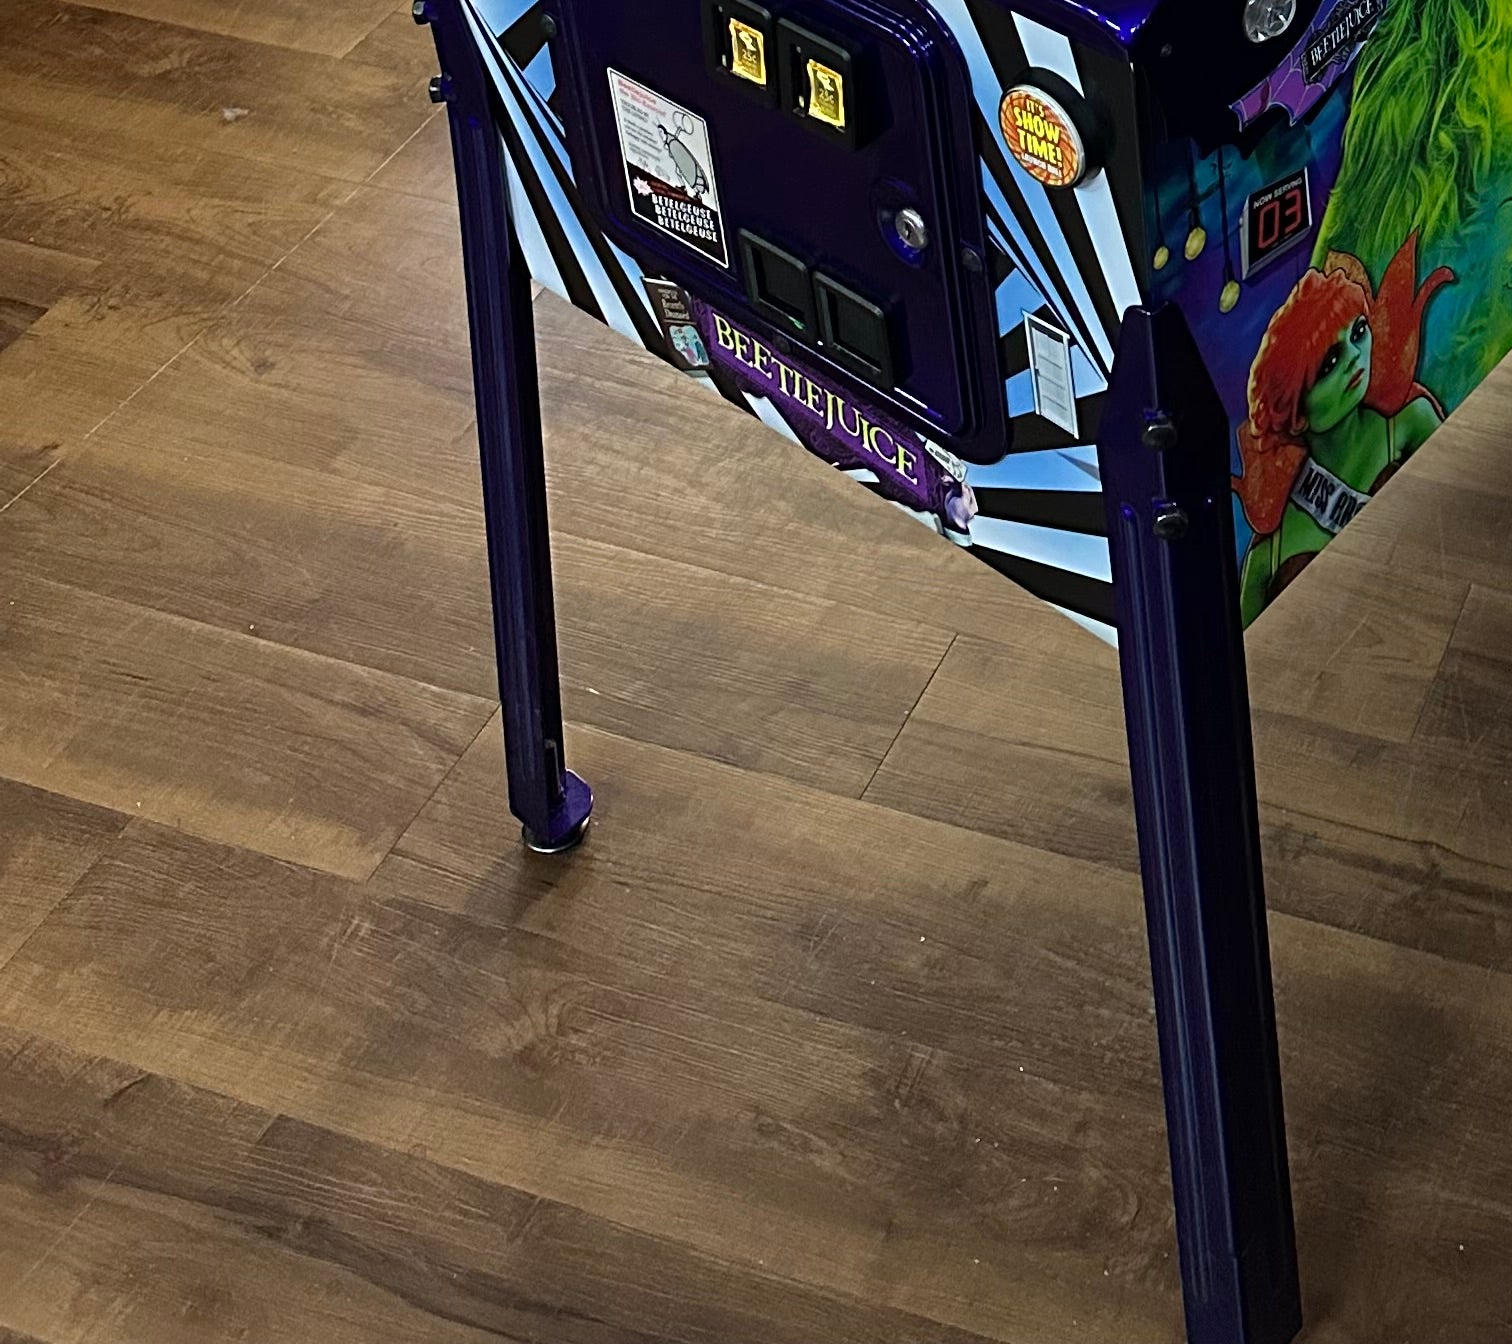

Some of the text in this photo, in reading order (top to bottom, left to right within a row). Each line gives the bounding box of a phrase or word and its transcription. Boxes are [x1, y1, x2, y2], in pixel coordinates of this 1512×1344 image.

[1013, 106, 1061, 144] SHOW
[1025, 98, 1045, 118] IT'S
[1016, 128, 1063, 169] TIME!
[651, 193, 712, 221] BETELGEUSE
[1253, 176, 1303, 210] NOW SERVING
[654, 203, 715, 231] BETELGEUSE
[657, 214, 718, 243] BETELGEUSE
[1257, 187, 1302, 250] 03
[712, 312, 919, 486] BEETLEJUICE
[1298, 467, 1336, 515] MISS
